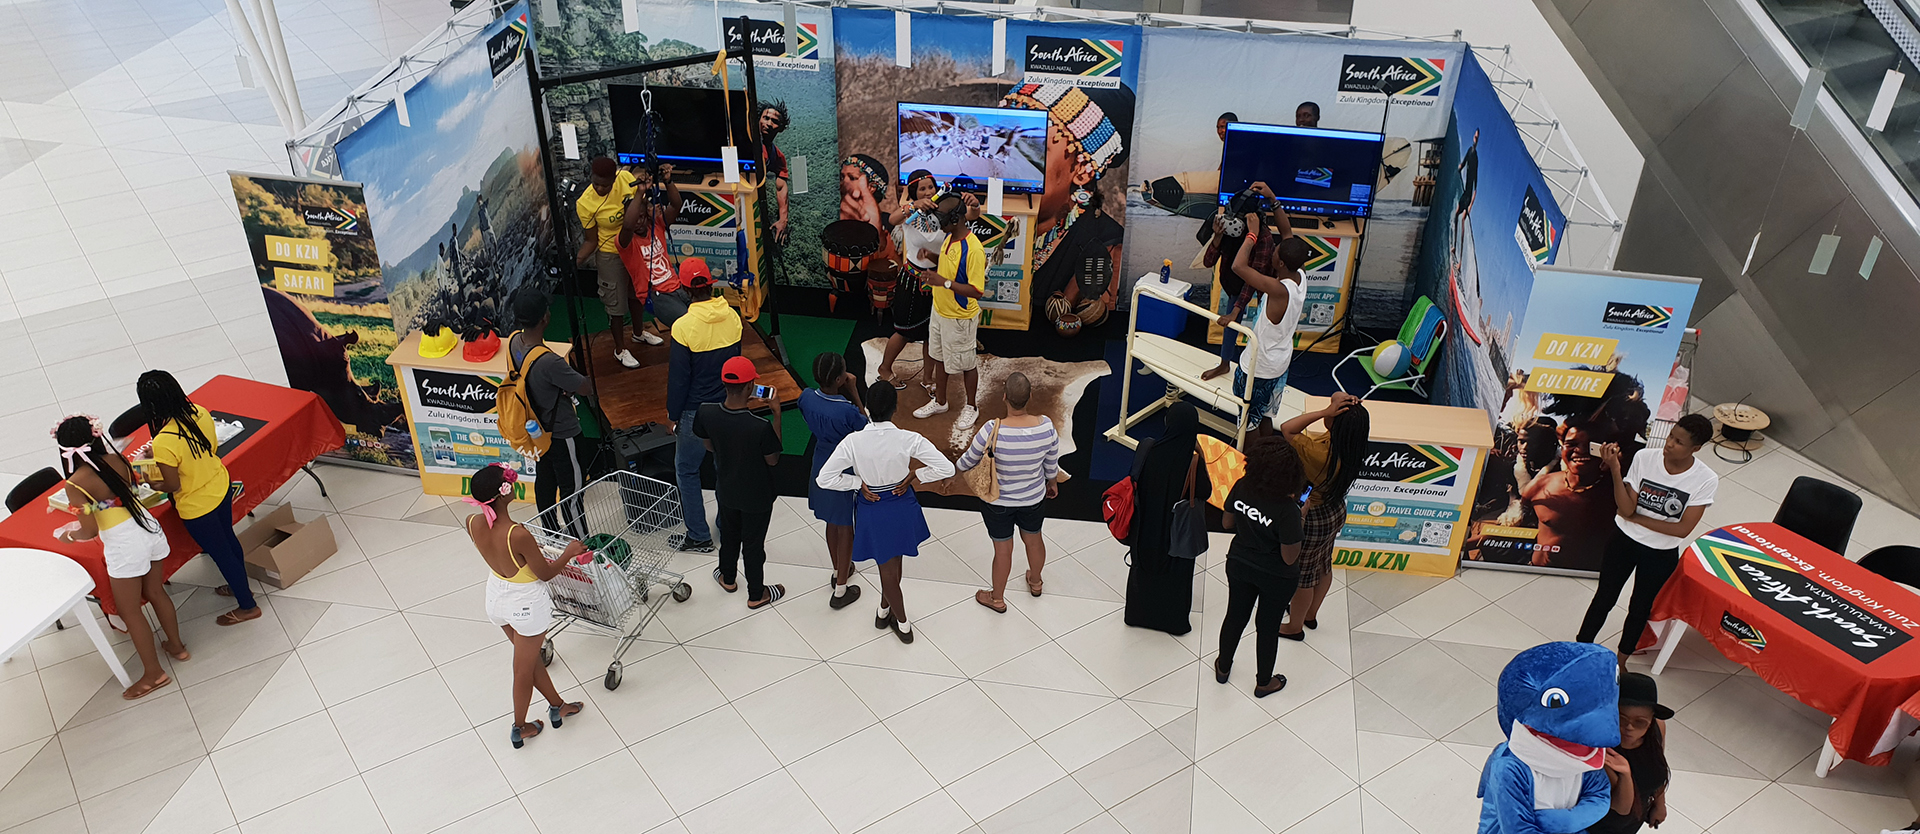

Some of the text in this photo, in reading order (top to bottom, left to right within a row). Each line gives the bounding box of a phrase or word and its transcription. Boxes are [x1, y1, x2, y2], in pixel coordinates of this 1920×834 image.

[728, 25, 761, 44] Soth
[1030, 44, 1098, 63] South Africa
[777, 60, 817, 70] Exceptional
[1030, 64, 1072, 72] KWAZULU-NATAL
[1346, 63, 1417, 81] South Africa
[1027, 75, 1117, 88] Zulu Kingdom. Exceptional
[1390, 98, 1434, 107] Exceptional
[680, 198, 712, 214] Africa
[305, 210, 343, 221] South Africa
[695, 229, 734, 237] Exceptional
[275, 242, 319, 260] DO KZN
[695, 247, 714, 255] TRAVEL
[715, 248, 730, 256] GUIDE
[283, 273, 325, 290] SAFARI
[1608, 306, 1654, 319] South Africa
[1545, 339, 1604, 360] DO KZN
[422, 378, 497, 401] South Afric
[1536, 372, 1602, 393] CULTURE
[427, 398, 474, 411] KWAZULU-NATAL
[428, 410, 445, 419] Zulu
[446, 413, 481, 424] Kingdom.
[456, 433, 468, 441] THE
[1381, 451, 1427, 469] Africa
[1351, 484, 1448, 496] Kingdom. Exceptional
[1640, 490, 1665, 504] CYCLE
[1234, 500, 1273, 527] crew
[1352, 504, 1366, 512] THE
[1386, 506, 1412, 515] TRAVEL
[1414, 508, 1437, 517] GUIDE
[1437, 510, 1453, 519] APP
[1483, 539, 1512, 548] #DoKZN
[1333, 549, 1411, 571] DO KZN
[1732, 525, 1920, 629] Zulu Kingdom. Exceptional
[1739, 563, 1886, 647] South Africa
[1804, 582, 1896, 636] KWAZULU-NATAL
